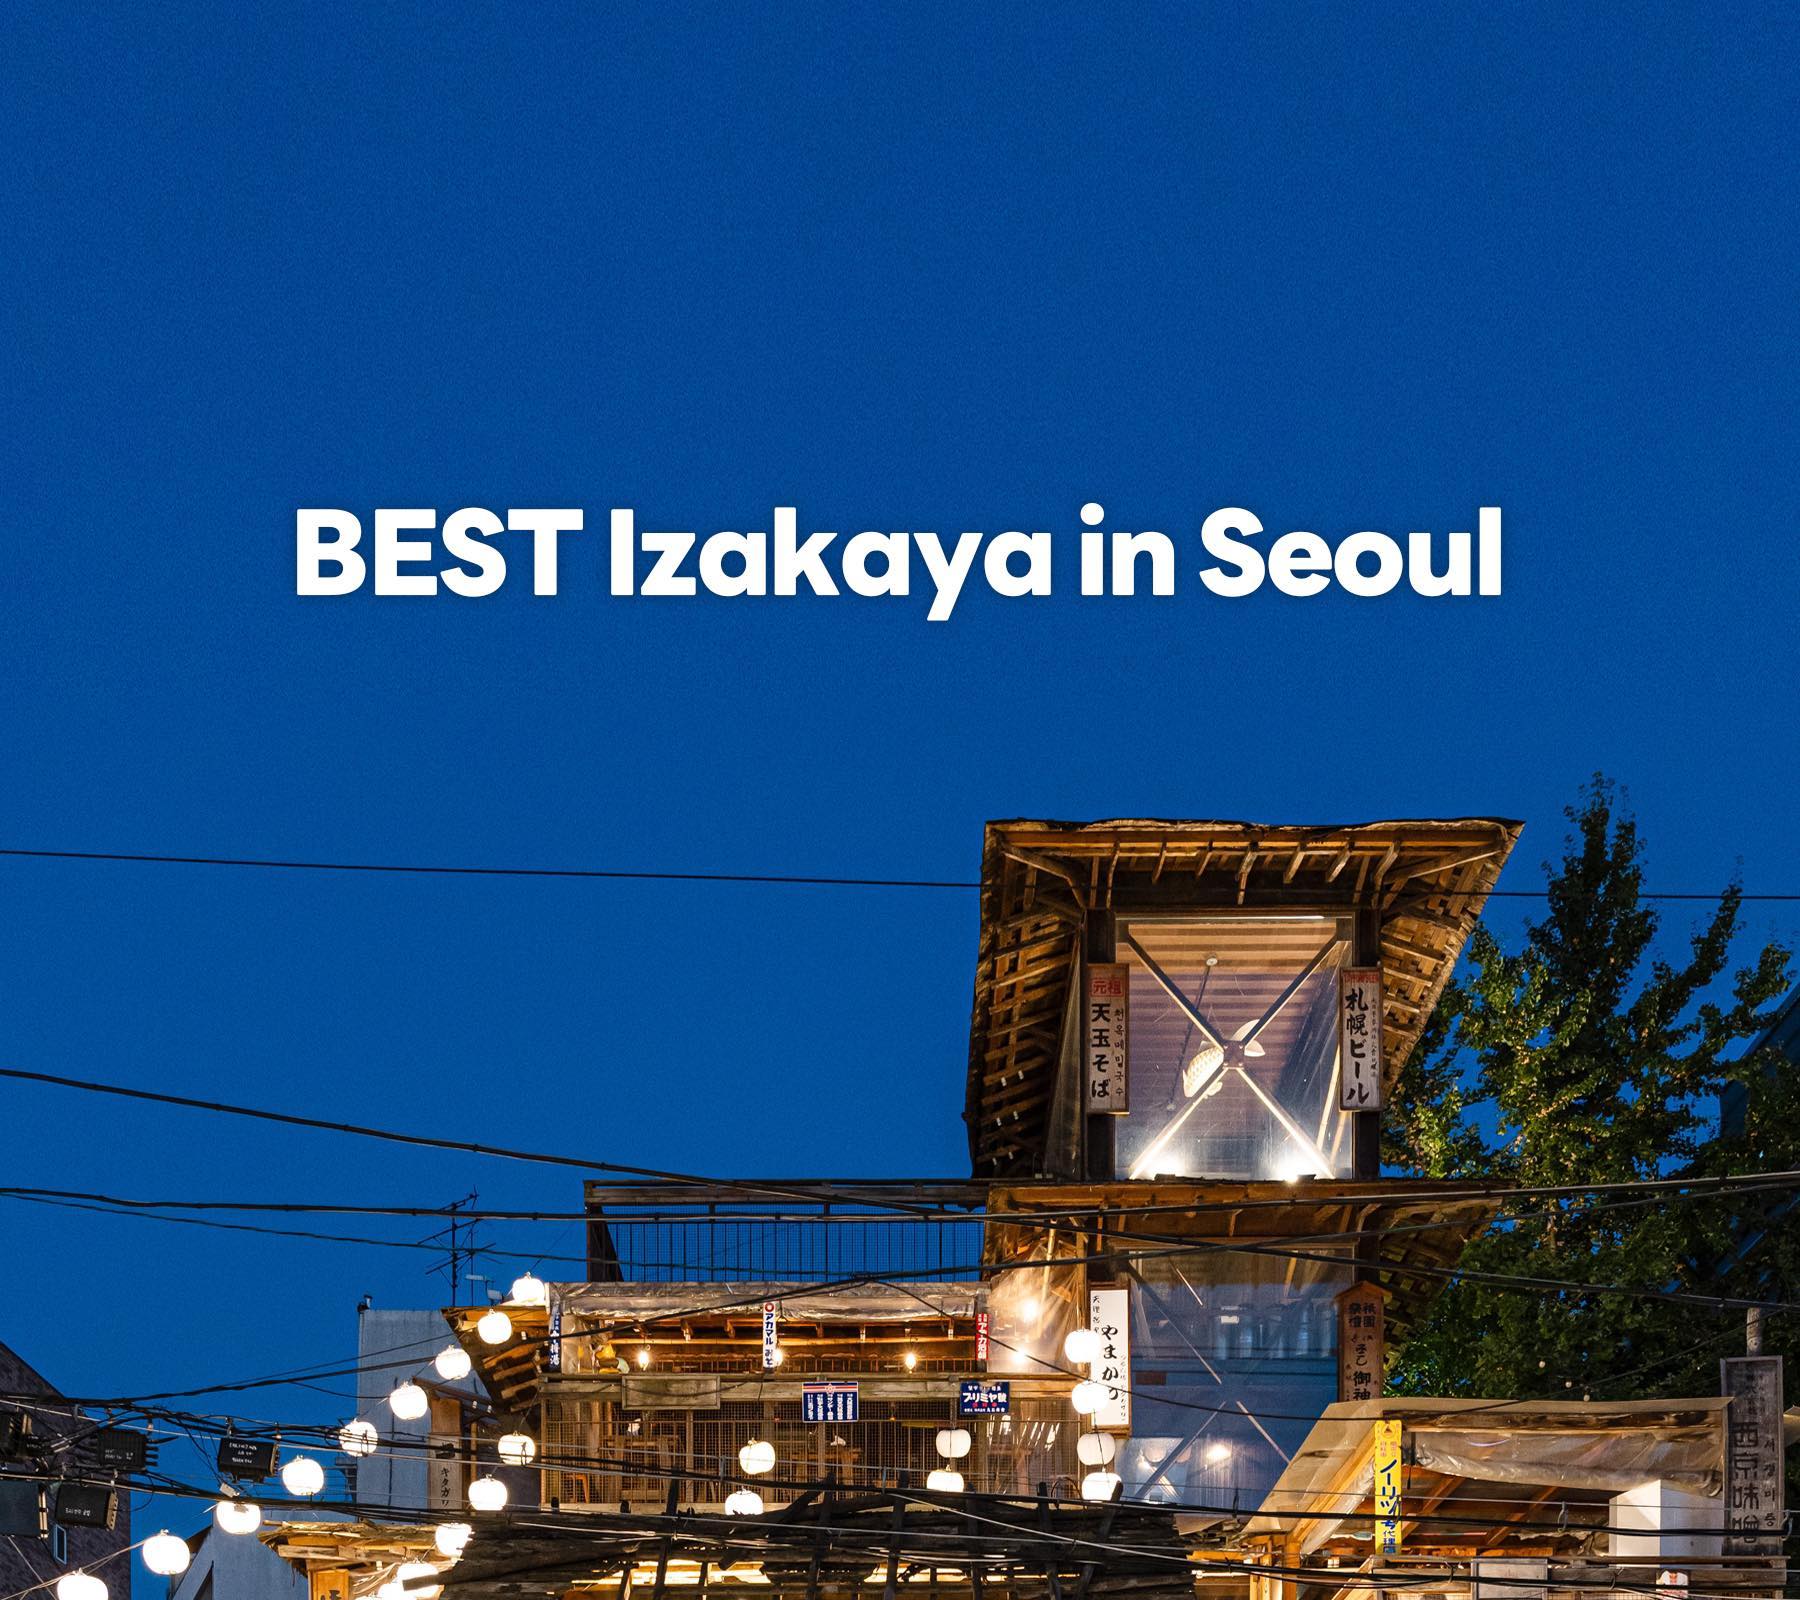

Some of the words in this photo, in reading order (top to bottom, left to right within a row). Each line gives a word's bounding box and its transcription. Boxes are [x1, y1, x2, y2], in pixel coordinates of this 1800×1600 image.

[1091, 1003, 1111, 1098] 天玉そば
[1345, 987, 1369, 1105] 札幌ビール
